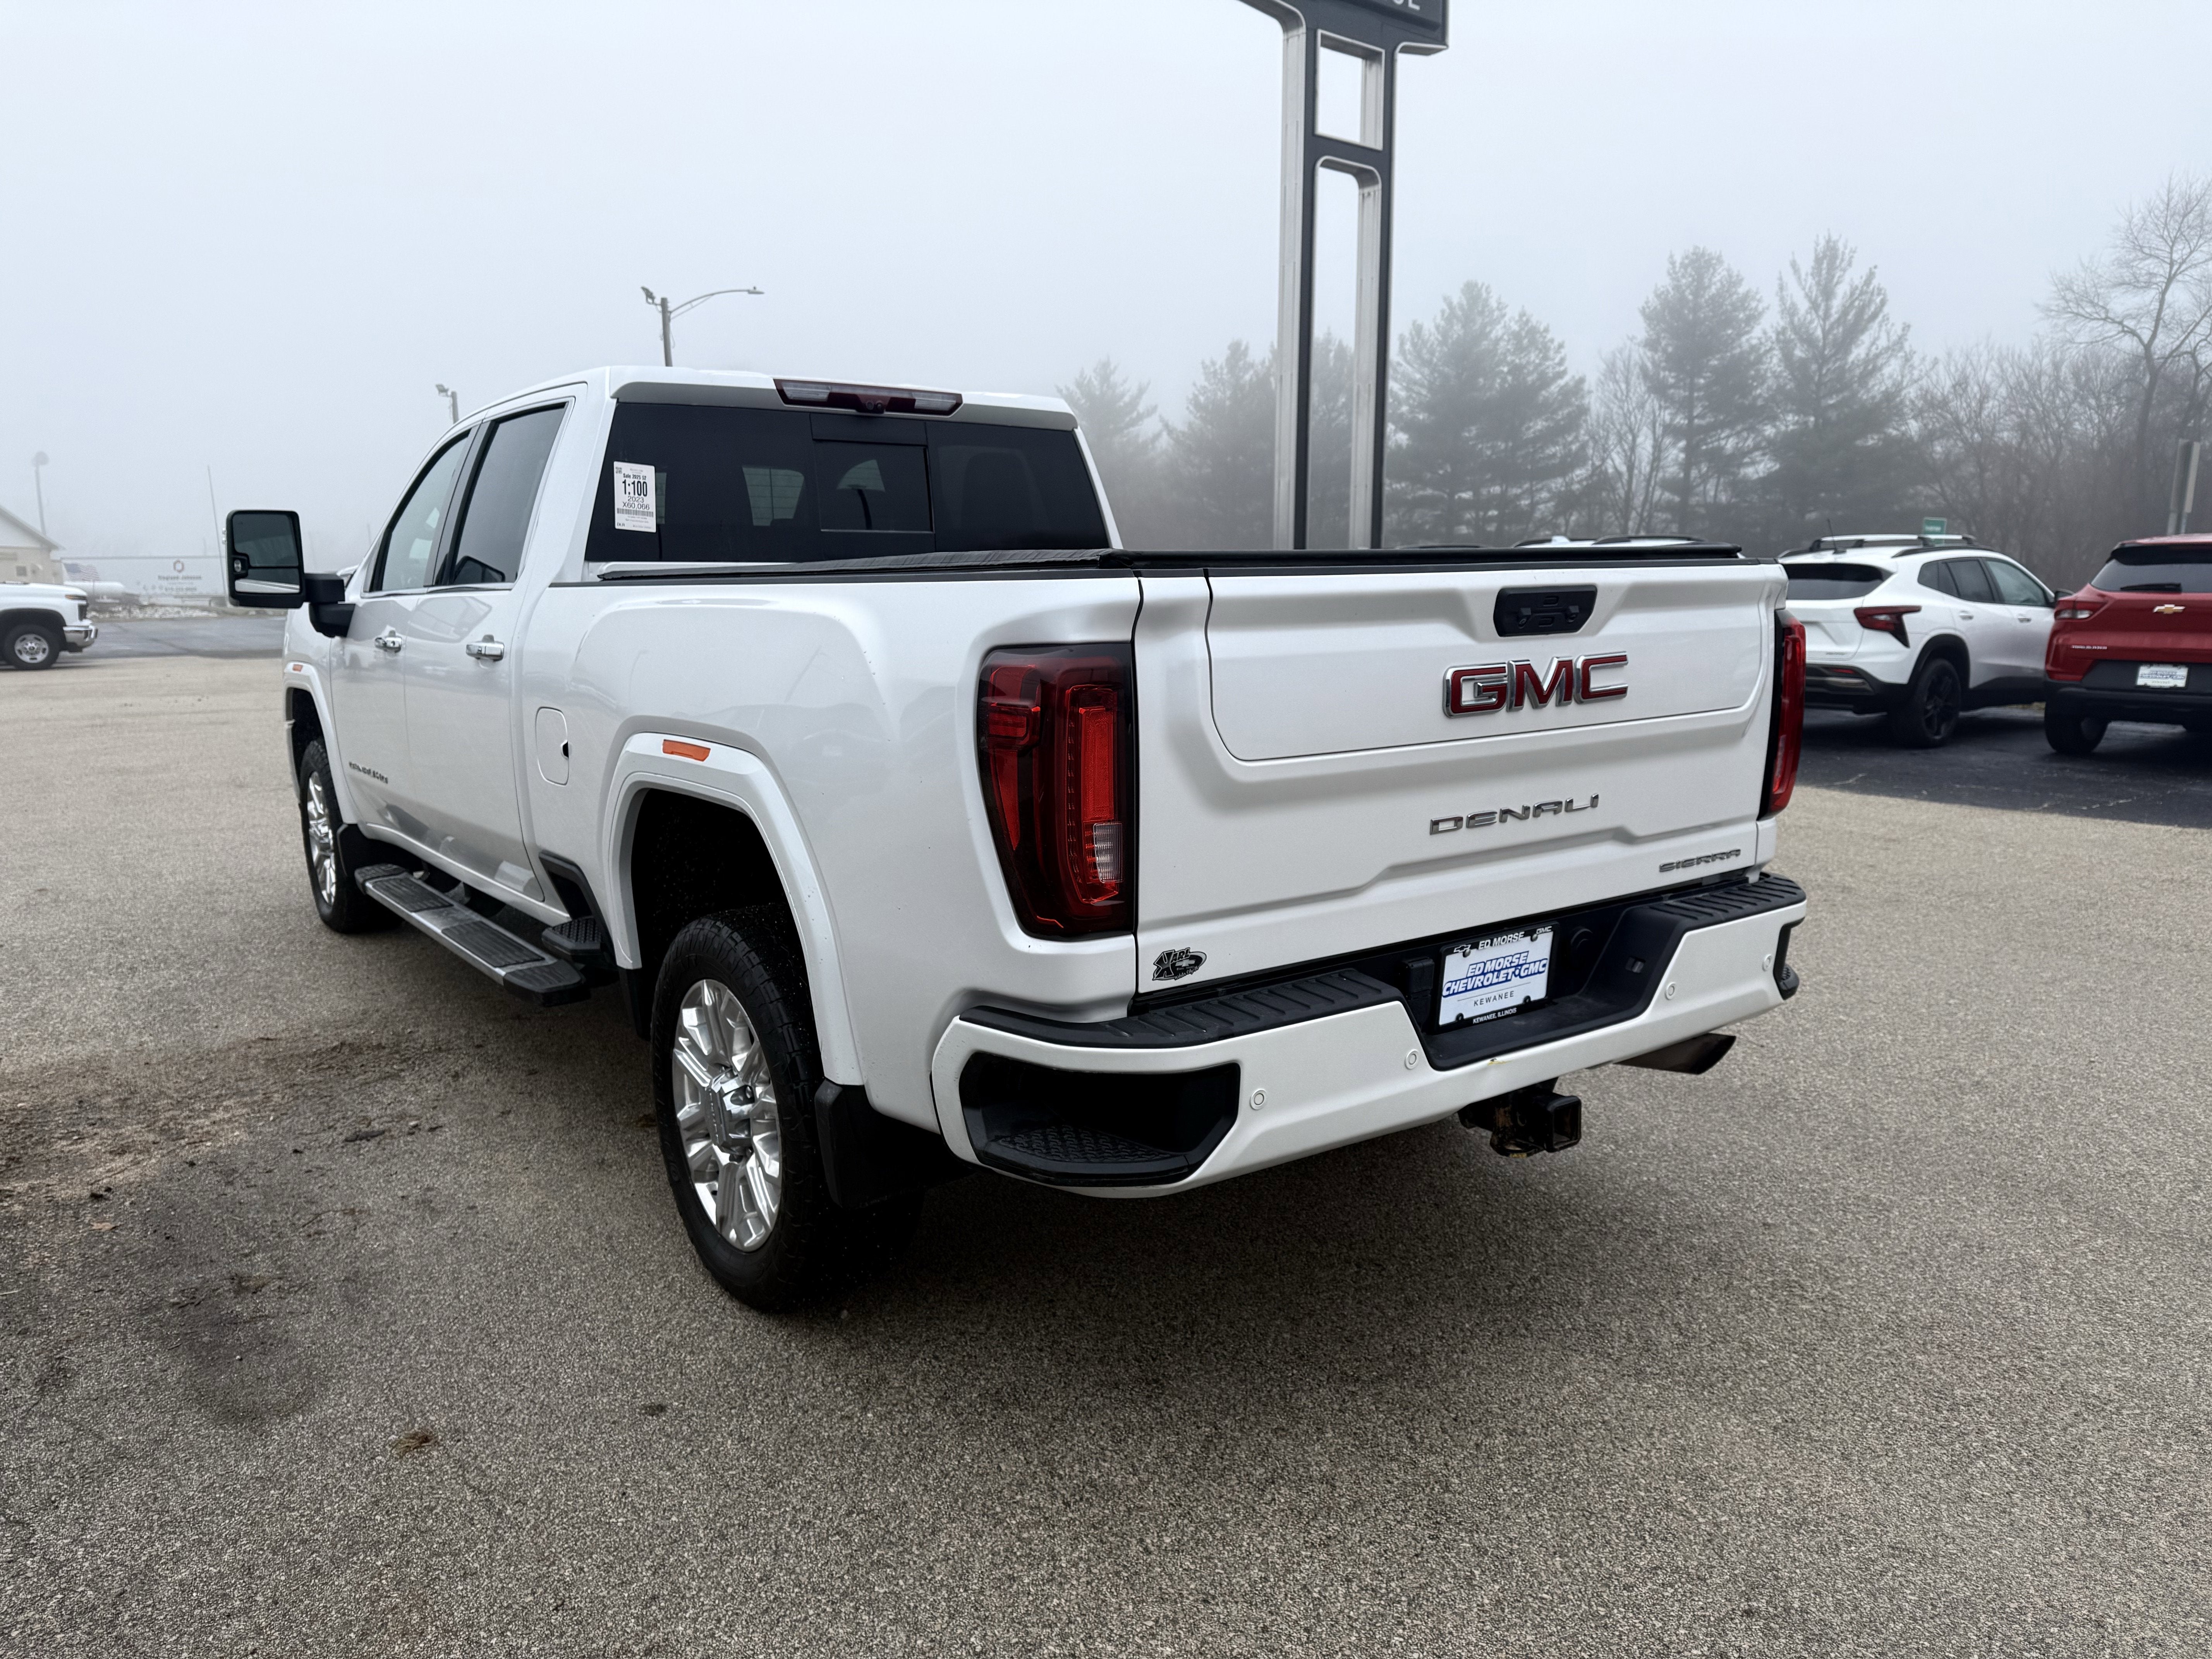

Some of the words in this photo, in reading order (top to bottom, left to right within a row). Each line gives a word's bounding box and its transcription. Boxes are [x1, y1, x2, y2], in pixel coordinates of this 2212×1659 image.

[622, 479, 647, 497] 1:100
[1443, 651, 1628, 718] GMC
[1430, 793, 1599, 835] DENALI
[1659, 848, 1741, 872] SIERRA
[1536, 926, 1553, 935] GMC
[1478, 939, 1491, 950] ED
[1492, 931, 1525, 947] MORSE
[1467, 961, 1486, 977] ED
[1484, 951, 1529, 973] MORSE
[1474, 991, 1515, 1006] KEWANEE
[1473, 1013, 1497, 1024] KEWANEE,
[1497, 1008, 1517, 1018] ILLINOIS
